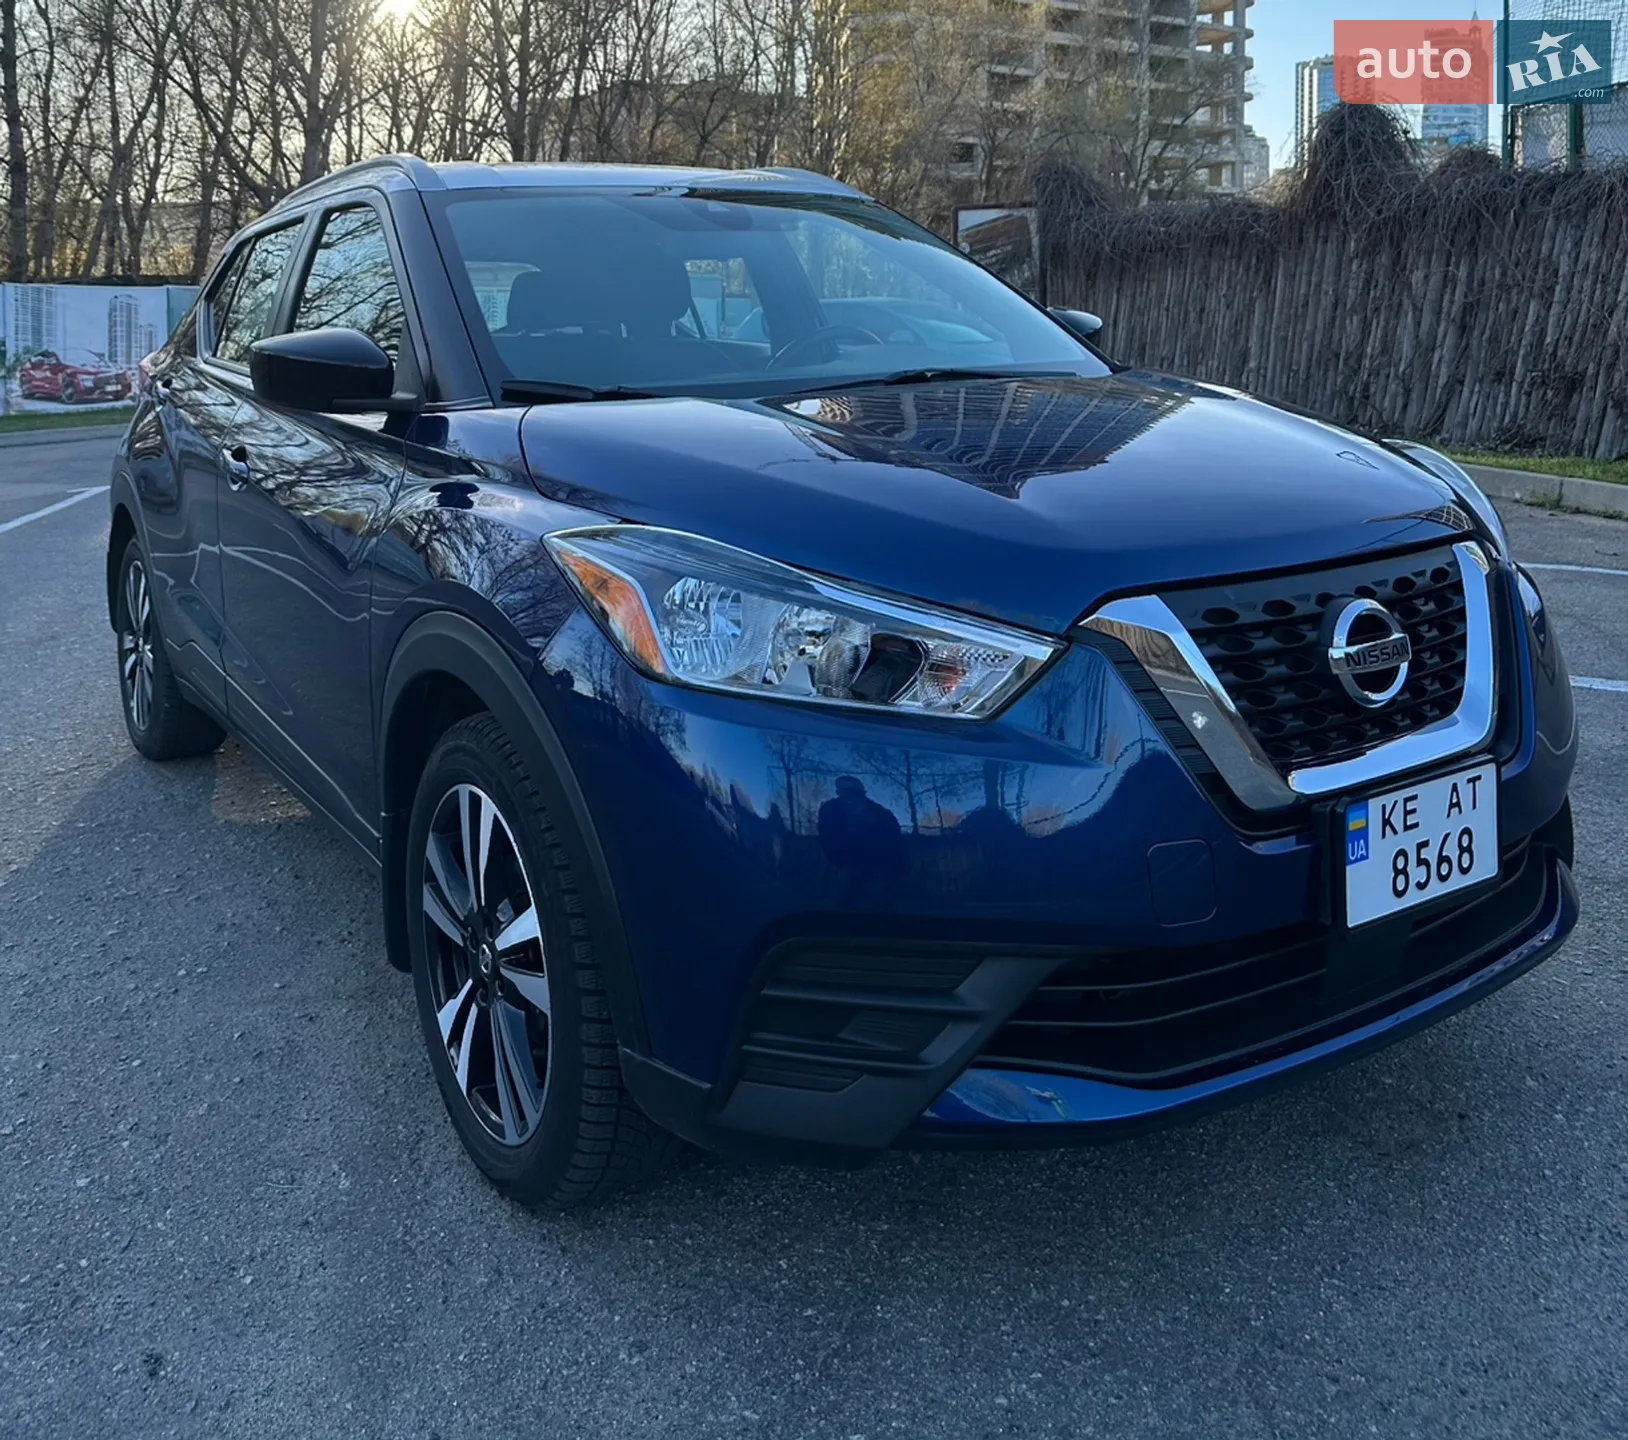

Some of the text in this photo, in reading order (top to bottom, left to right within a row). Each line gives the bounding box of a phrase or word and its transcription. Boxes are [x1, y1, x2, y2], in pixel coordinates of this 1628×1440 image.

[1344, 642, 1410, 668] NISSAN
[1381, 774, 1482, 840] KE AT
[1348, 839, 1367, 860] UA
[1392, 826, 1474, 899] 8568
